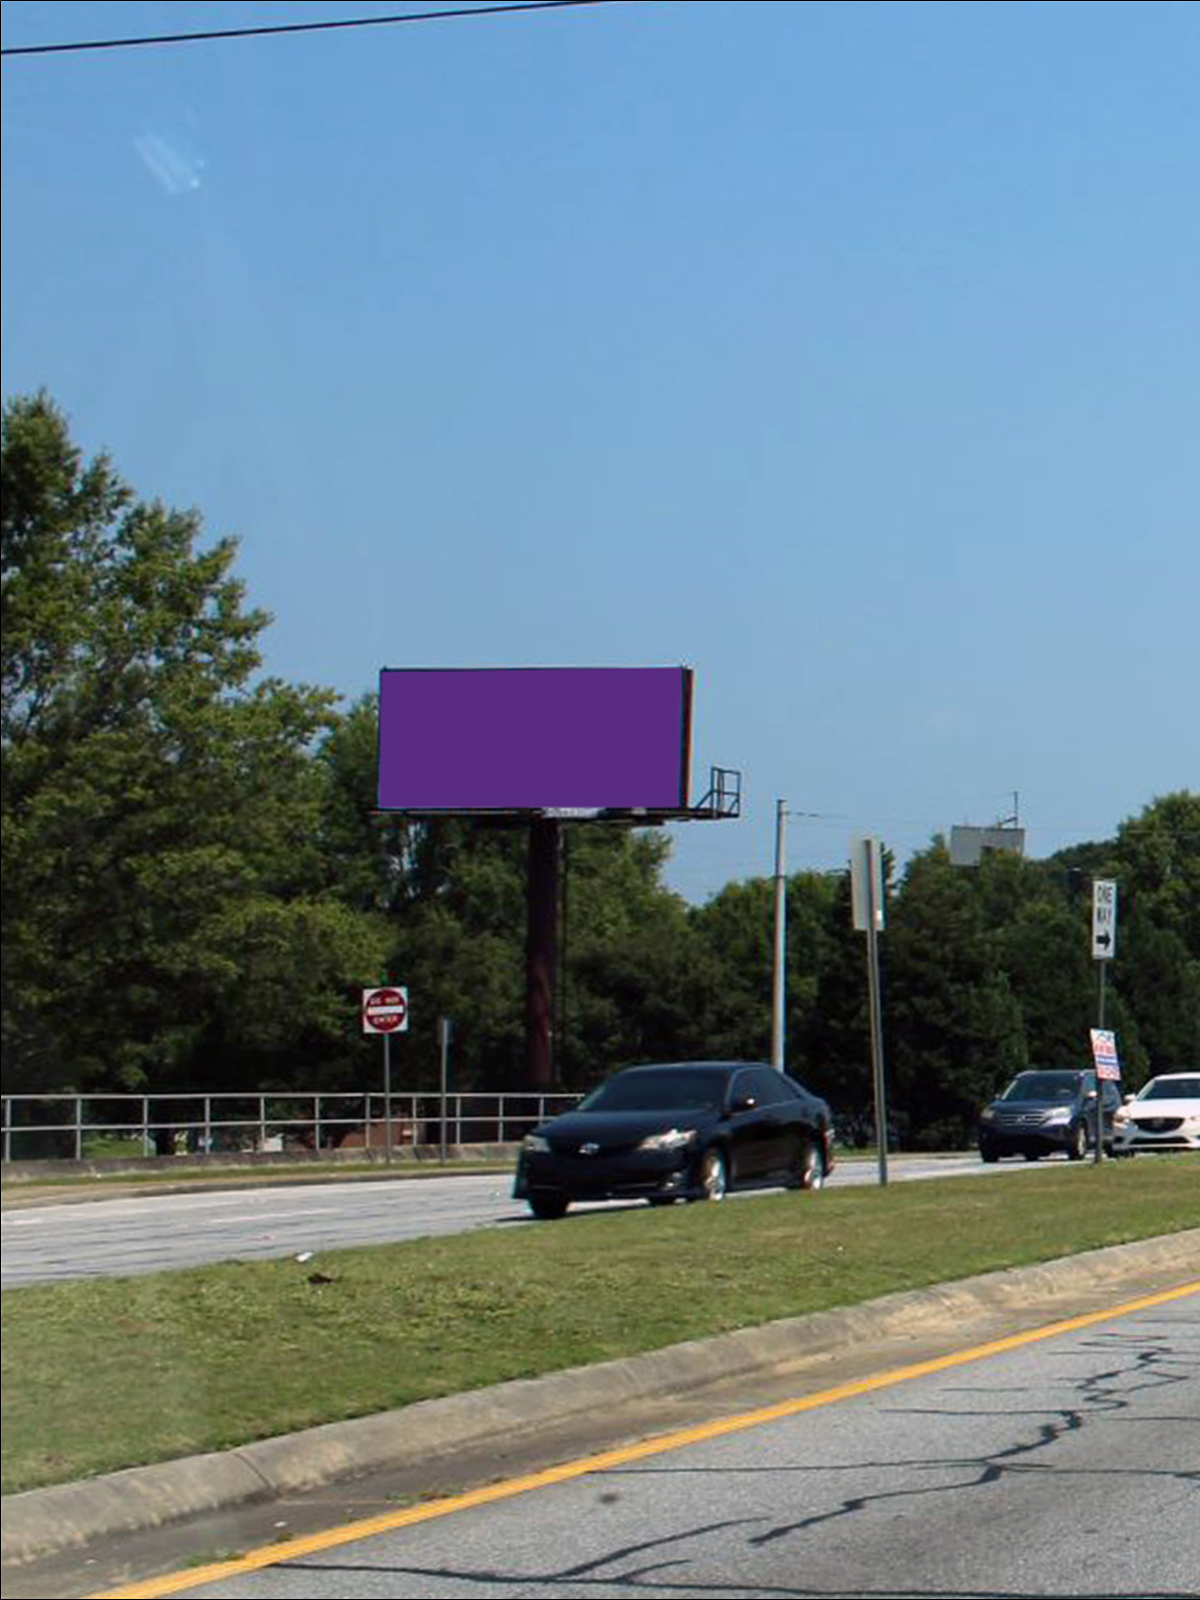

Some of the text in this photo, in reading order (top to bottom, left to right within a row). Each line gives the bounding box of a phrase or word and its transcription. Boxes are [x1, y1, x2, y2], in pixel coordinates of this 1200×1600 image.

[1097, 886, 1113, 903] ONE
[1097, 907, 1112, 924] WAY
[373, 1015, 398, 1024] ENTER
